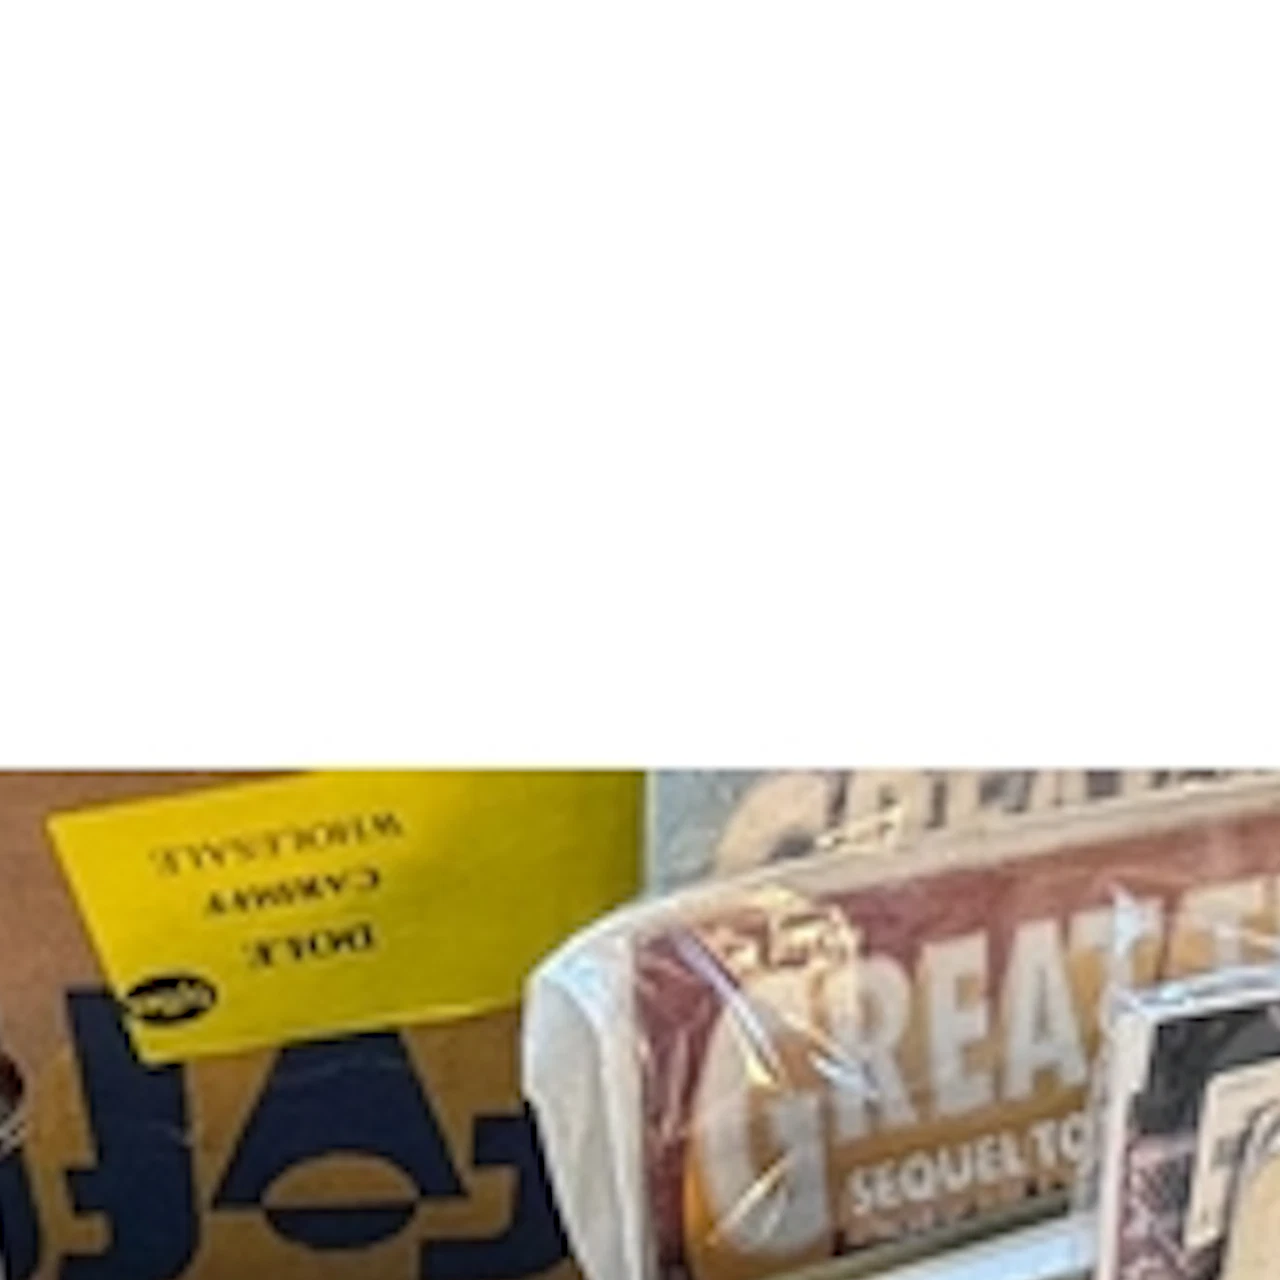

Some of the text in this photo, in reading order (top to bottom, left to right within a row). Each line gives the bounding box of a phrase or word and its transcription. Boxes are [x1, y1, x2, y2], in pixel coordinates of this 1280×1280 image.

[148, 812, 404, 877] WHOLESALE
[244, 922, 374, 968] DOLE
[849, 1134, 1026, 1217] SEQUEL
[1032, 1114, 1092, 1172] TO
